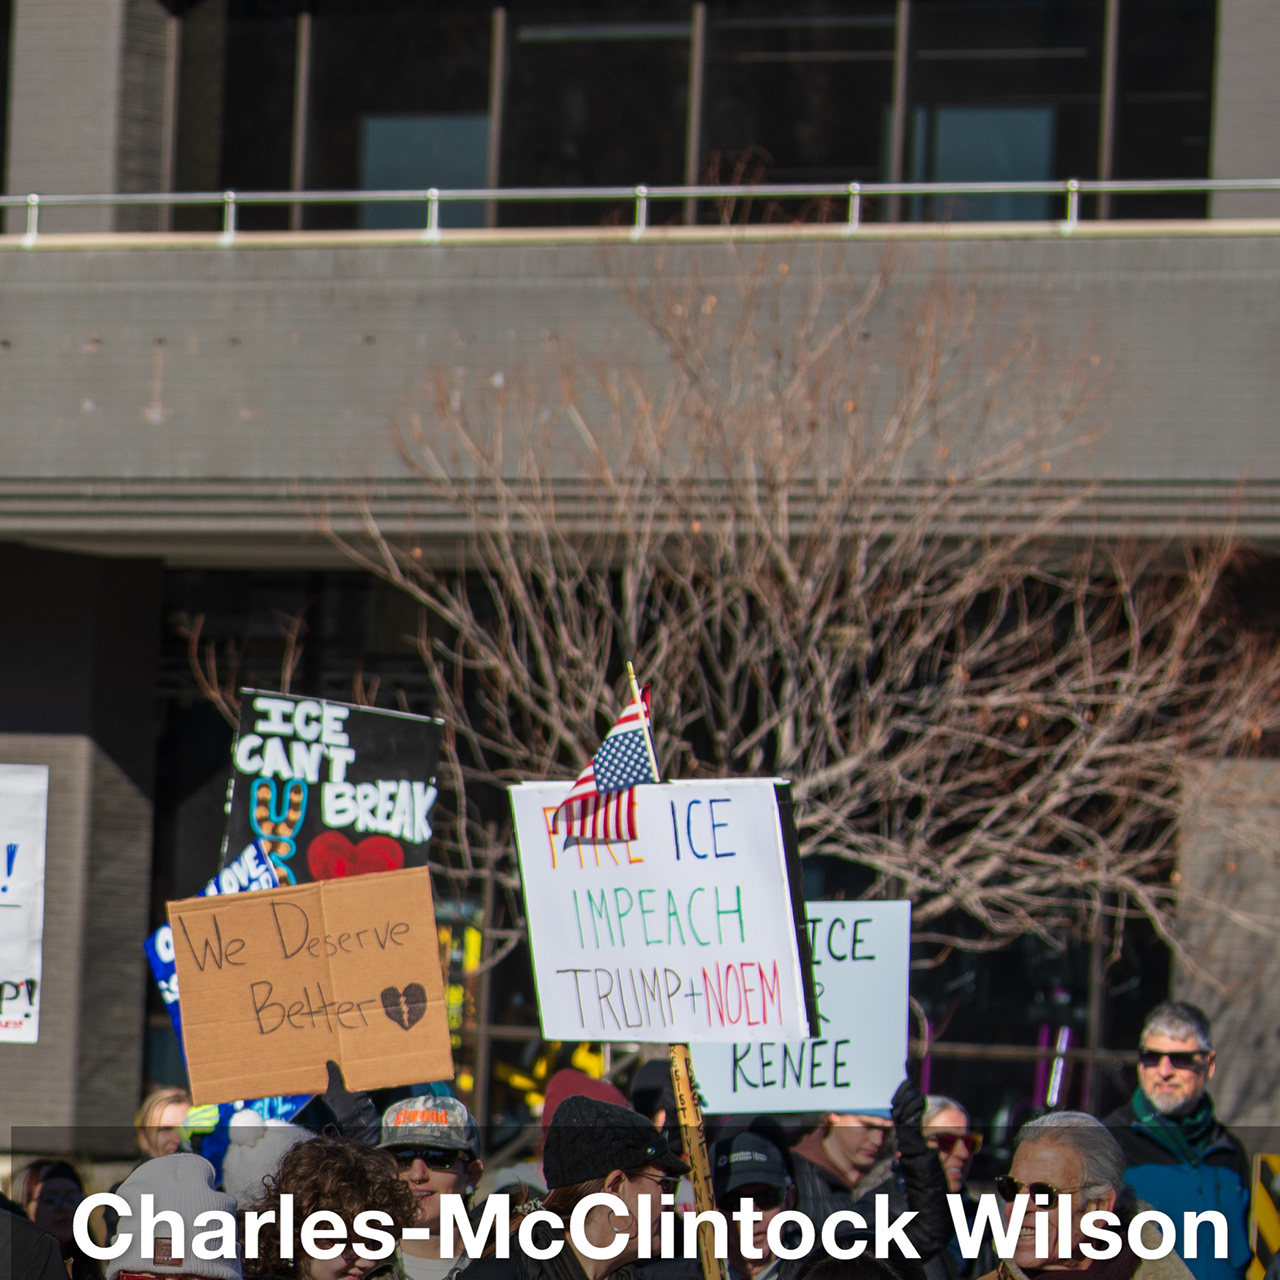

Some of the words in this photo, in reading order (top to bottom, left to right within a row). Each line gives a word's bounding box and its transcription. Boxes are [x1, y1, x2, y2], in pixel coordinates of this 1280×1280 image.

[252, 697, 350, 747] ICE
[234, 734, 356, 785] CAN'T
[320, 780, 438, 845] BREAK
[669, 798, 738, 862] ICE
[177, 913, 248, 973] We
[269, 898, 412, 960] Deserve
[572, 885, 747, 950] IMPEACH
[250, 980, 378, 1035] Better
